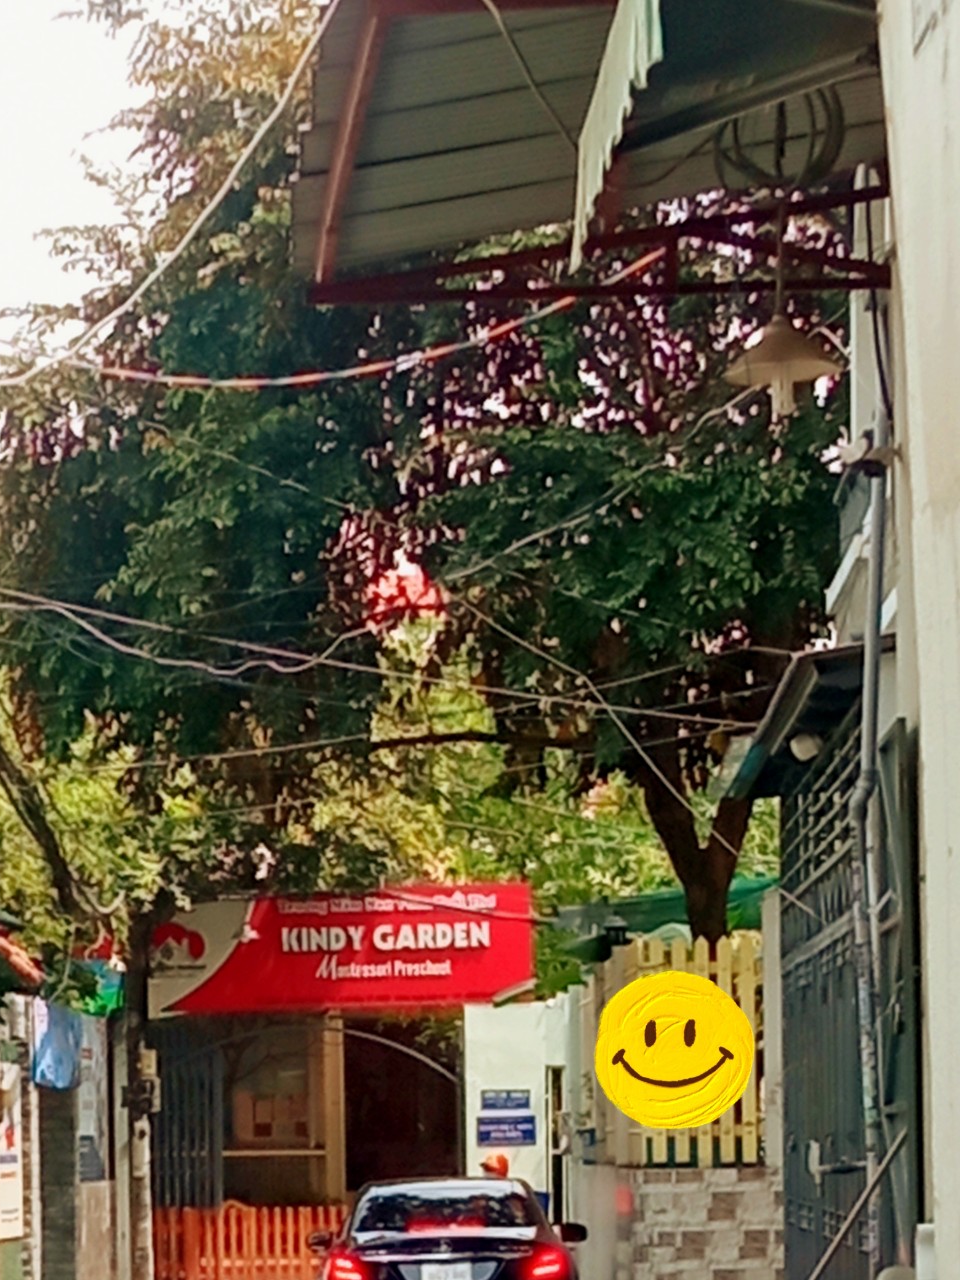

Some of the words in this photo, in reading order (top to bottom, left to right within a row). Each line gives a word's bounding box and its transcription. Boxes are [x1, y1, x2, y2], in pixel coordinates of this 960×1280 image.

[281, 925, 365, 952] KINDY
[372, 921, 491, 951] GARDEN
[315, 954, 391, 980] Montessori
[393, 960, 452, 977] Preschool
